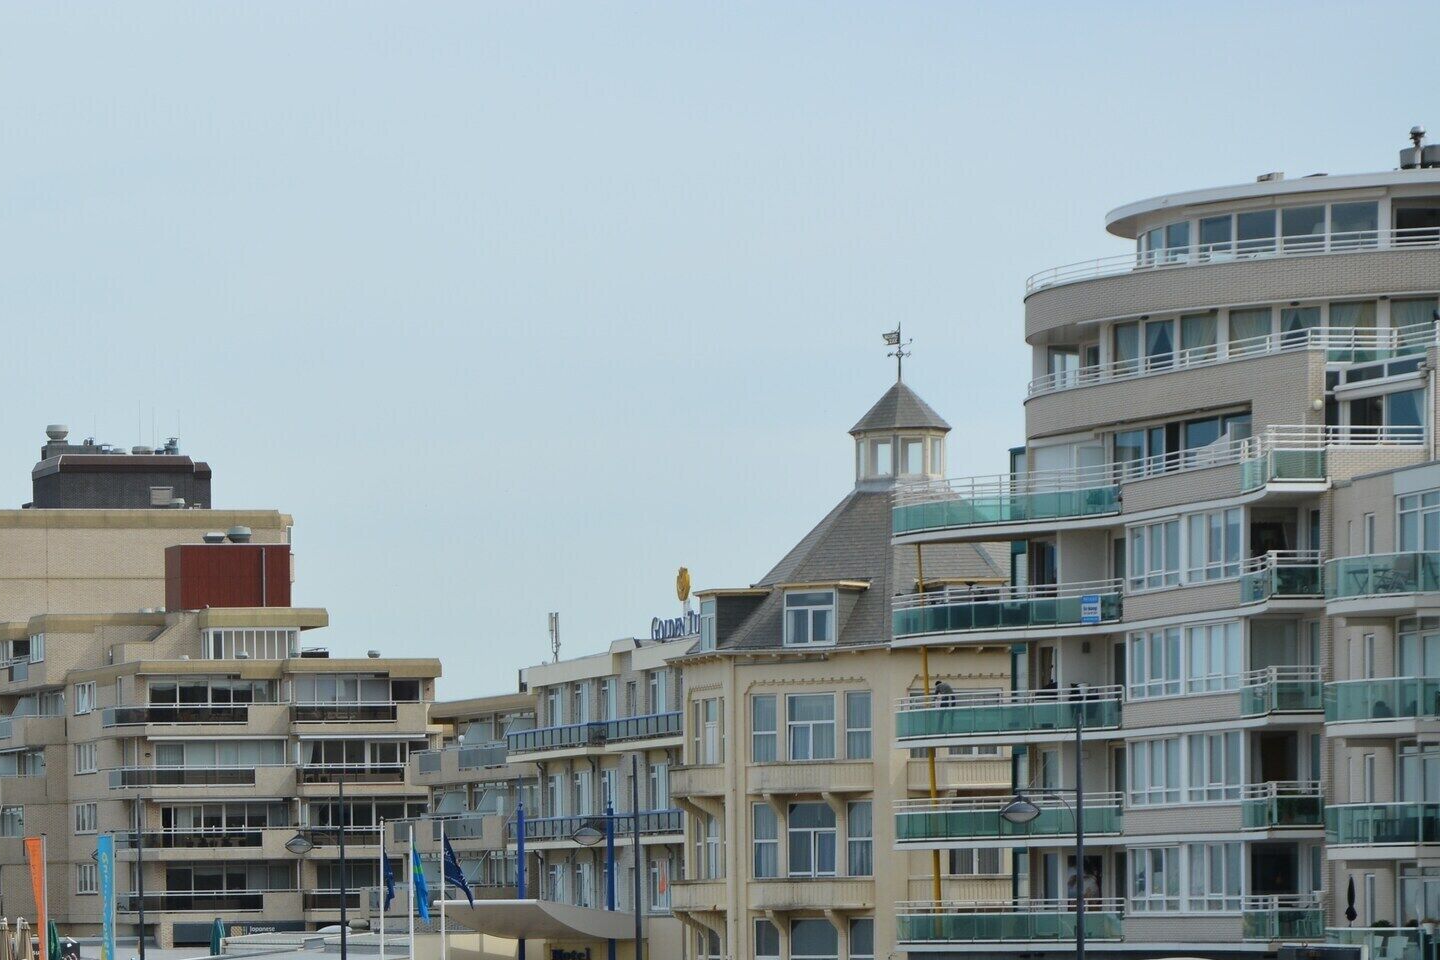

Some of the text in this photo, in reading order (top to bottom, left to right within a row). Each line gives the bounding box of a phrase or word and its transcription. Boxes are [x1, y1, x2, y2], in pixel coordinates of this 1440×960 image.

[651, 610, 700, 641] GOLDEN TU
[551, 947, 591, 960] Hotel
